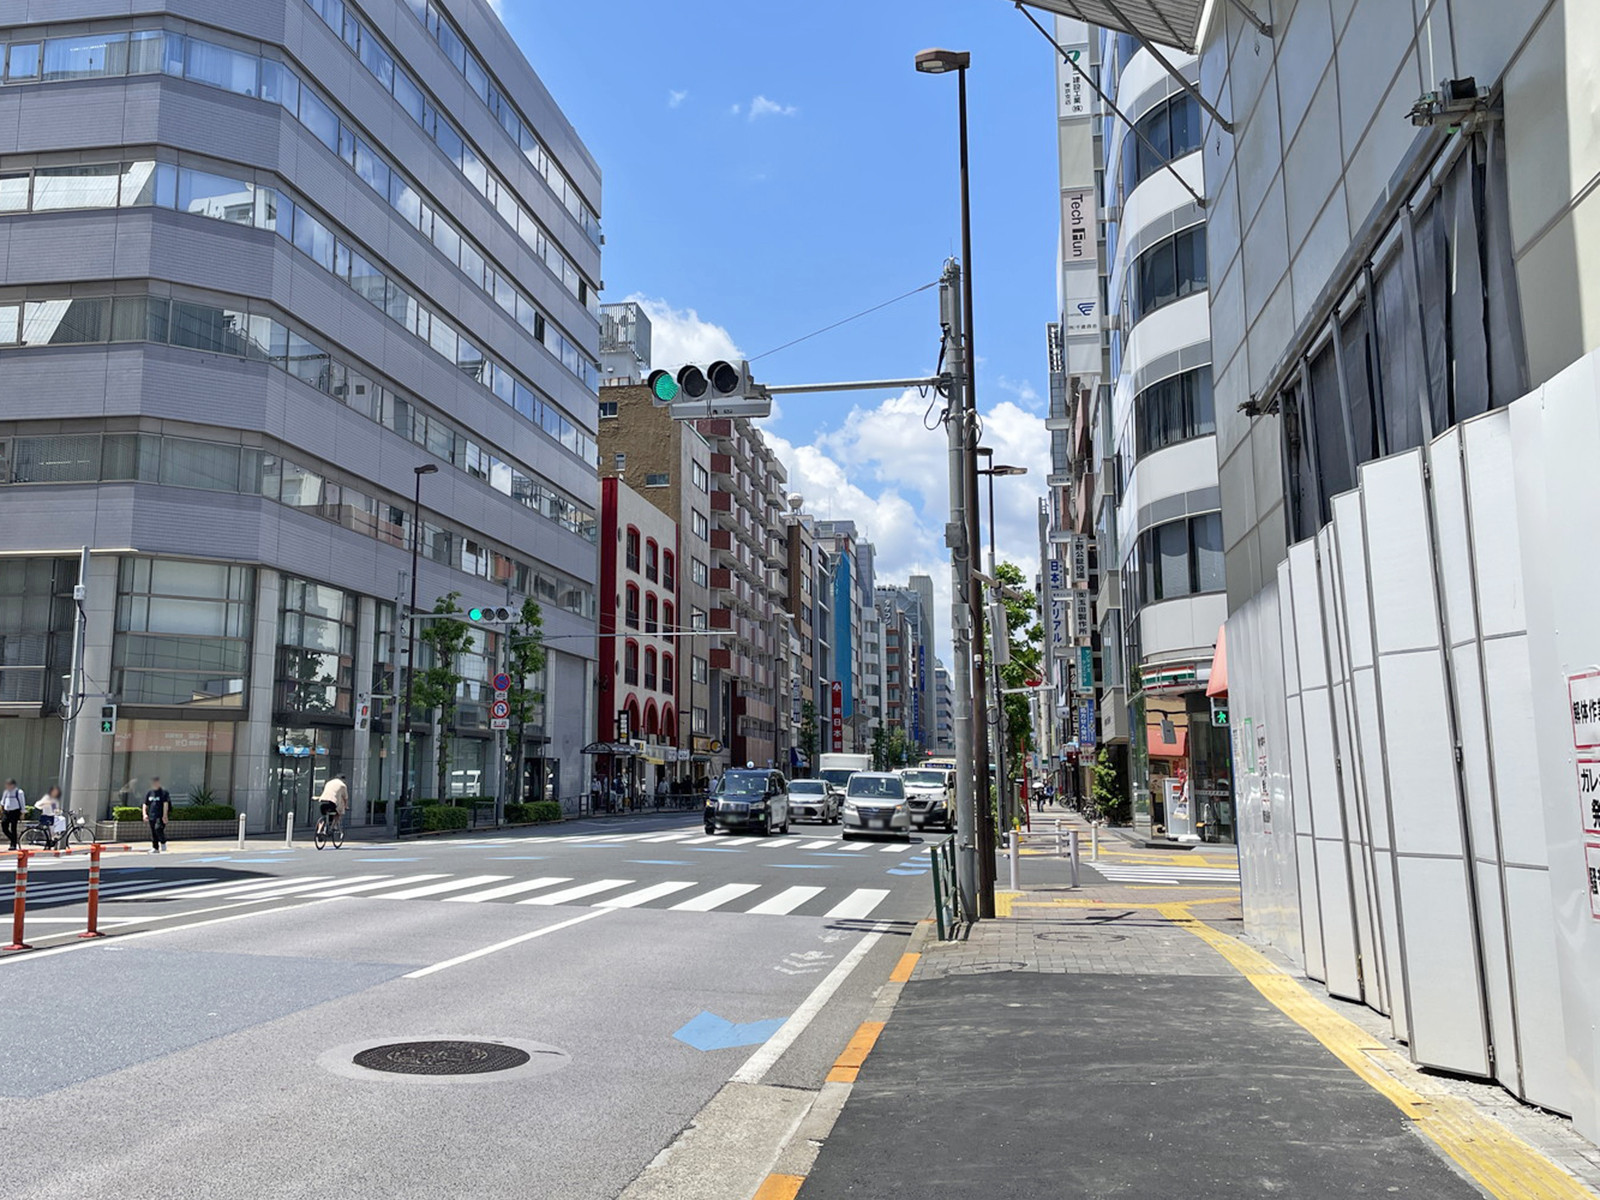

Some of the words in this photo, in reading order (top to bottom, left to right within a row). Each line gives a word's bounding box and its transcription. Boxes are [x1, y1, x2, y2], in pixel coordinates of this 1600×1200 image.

[1071, 193, 1083, 226] Tech
[1072, 228, 1086, 258] Fun
[1581, 768, 1600, 793] ガレ
